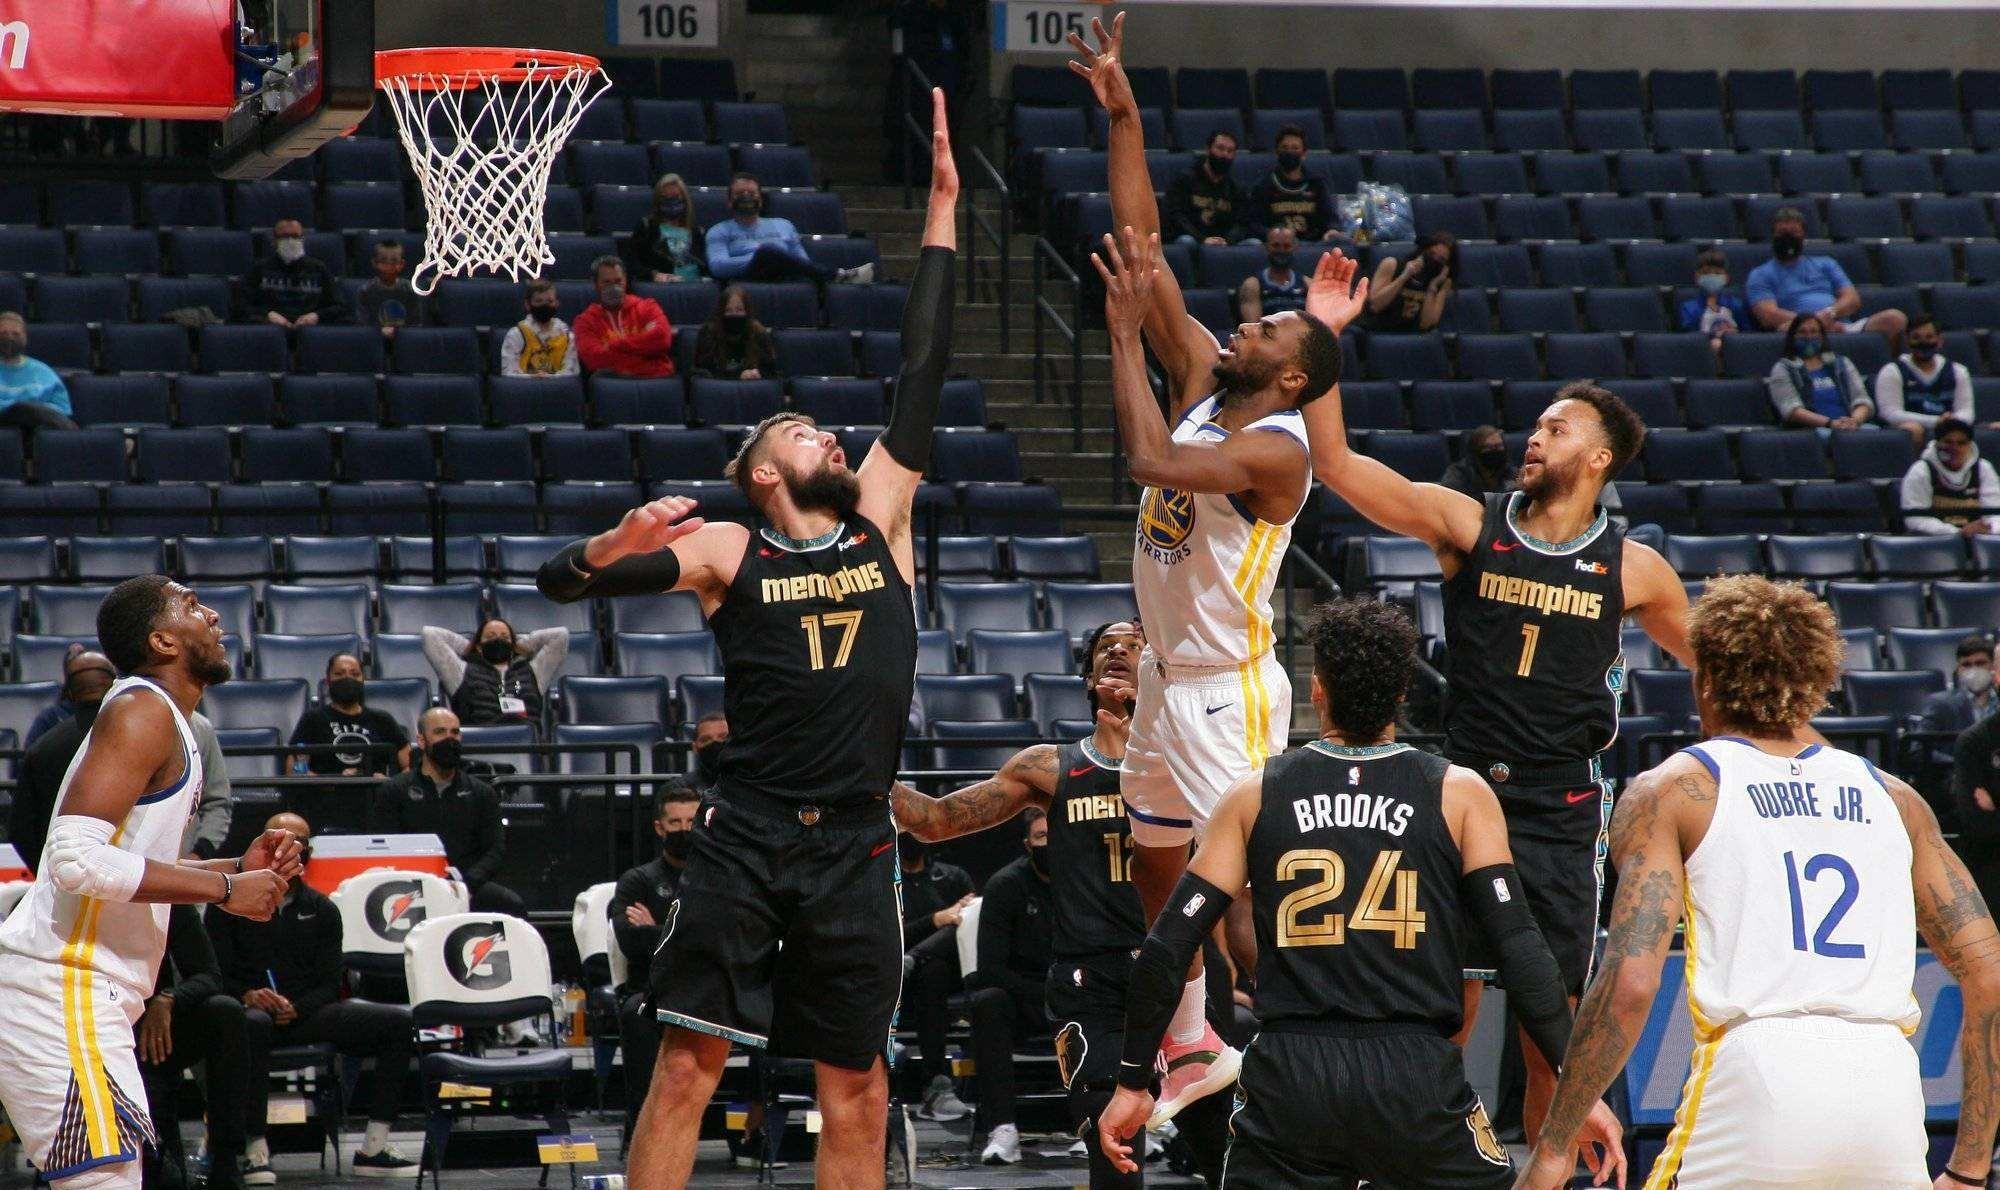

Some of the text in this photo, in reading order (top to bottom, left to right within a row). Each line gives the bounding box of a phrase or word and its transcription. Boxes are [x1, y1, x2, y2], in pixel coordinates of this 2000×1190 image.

[638, 4, 697, 38] 106
[1025, 10, 1085, 44] 105
[838, 532, 869, 551] FedEx
[1575, 558, 1608, 575] FedEx
[800, 610, 864, 670] 17
[1518, 623, 1540, 677] 1
[1293, 793, 1414, 837] BROOKS
[1747, 781, 1872, 824] OUBRE JR.
[1276, 849, 1426, 950] 24
[1783, 850, 1866, 959] 12
[444, 921, 512, 991] G
